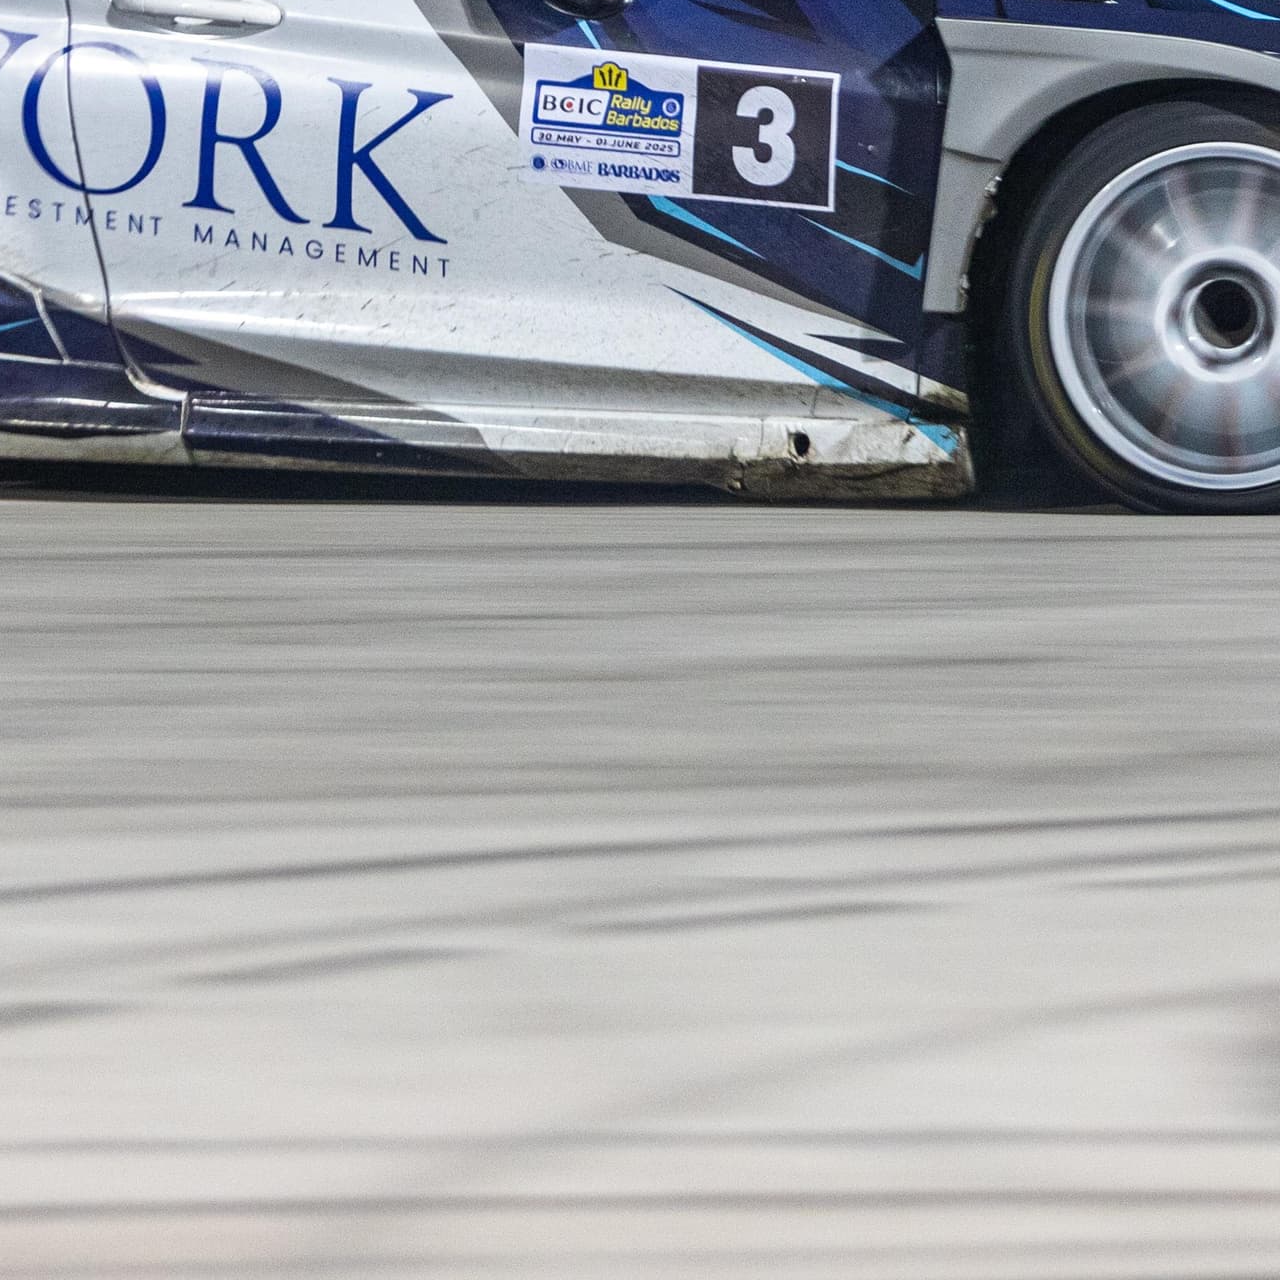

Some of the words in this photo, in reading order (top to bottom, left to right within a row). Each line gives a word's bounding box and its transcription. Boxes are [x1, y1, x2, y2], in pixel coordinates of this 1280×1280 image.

[542, 94, 603, 116] BCIC
[610, 94, 653, 115] Rally
[605, 110, 680, 132] Barbados
[538, 132, 552, 141] 30
[556, 134, 582, 144] MAY
[611, 138, 641, 150] JUNE
[644, 141, 674, 153] 2025
[731, 85, 796, 186] 3
[193, 223, 451, 278] MANAGEMENT
